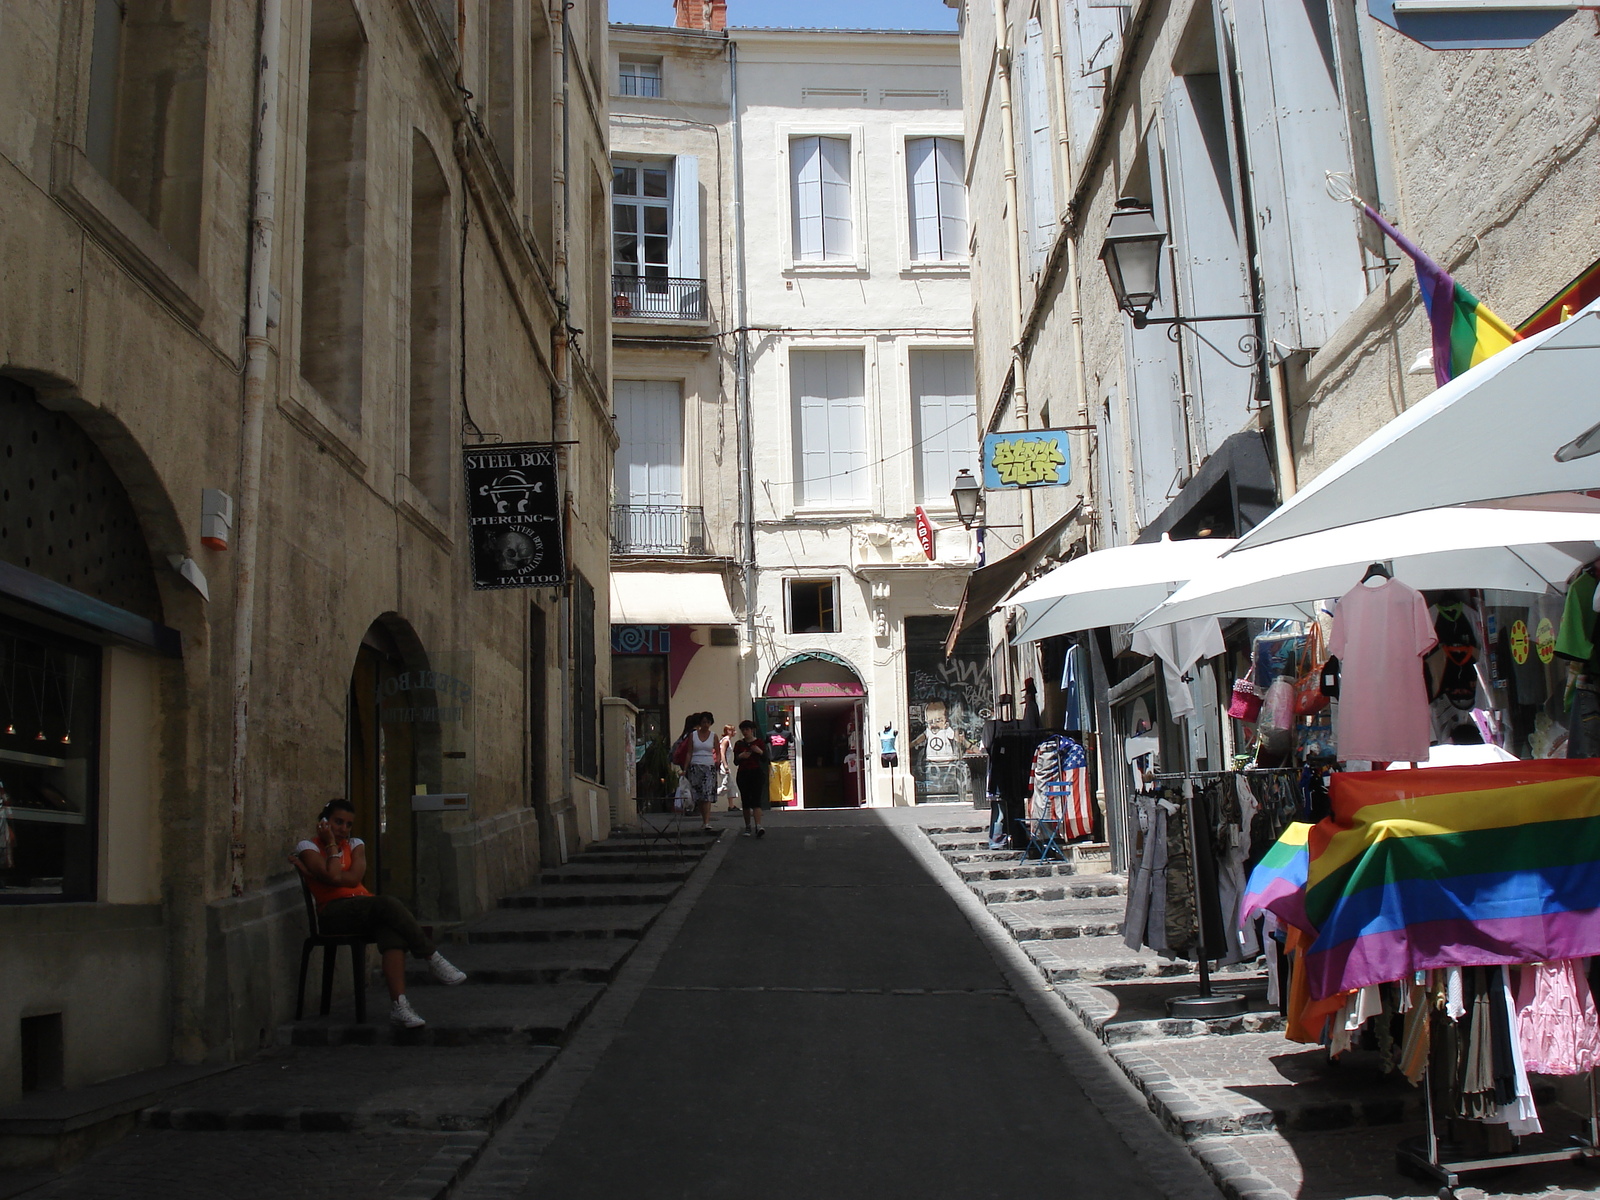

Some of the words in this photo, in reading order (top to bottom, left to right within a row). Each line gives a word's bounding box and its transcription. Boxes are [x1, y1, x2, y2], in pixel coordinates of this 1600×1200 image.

[467, 454, 516, 469] STEEL
[521, 452, 552, 467] BOX
[997, 461, 1059, 485] USA
[472, 514, 543, 525] PIERCING
[509, 525, 534, 538] STEEL
[916, 513, 930, 551] TABAC
[533, 535, 544, 550] BOX
[517, 551, 544, 575] TATTOO
[497, 574, 560, 585] TATTOO
